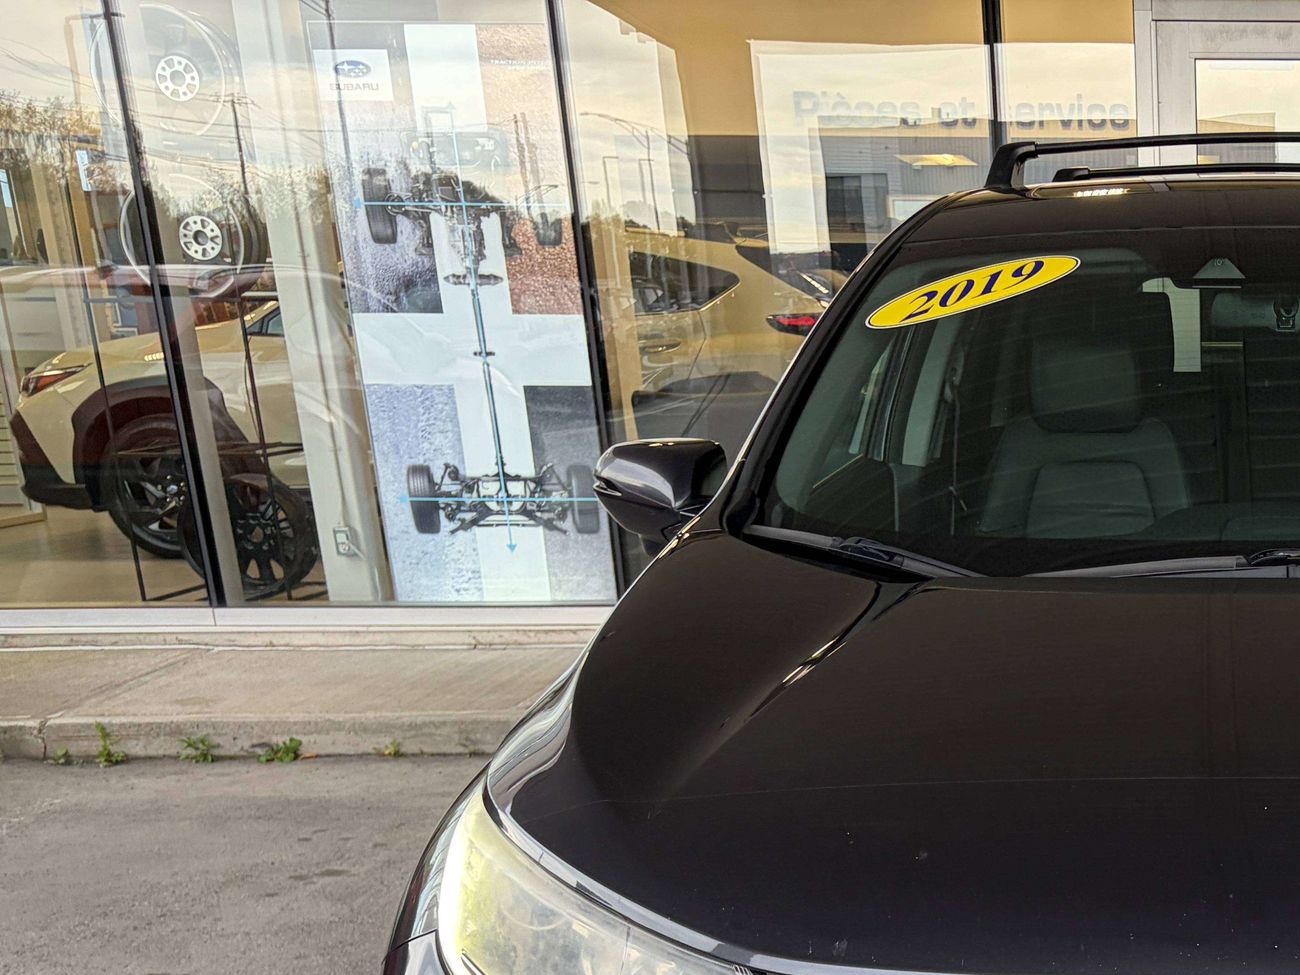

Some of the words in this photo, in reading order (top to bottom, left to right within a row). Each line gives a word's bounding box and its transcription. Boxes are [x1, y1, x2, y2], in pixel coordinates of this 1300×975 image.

[329, 83, 379, 91] SUBARU
[939, 96, 977, 129] et
[1008, 93, 1130, 131] ervice
[900, 260, 1045, 322] 2019
